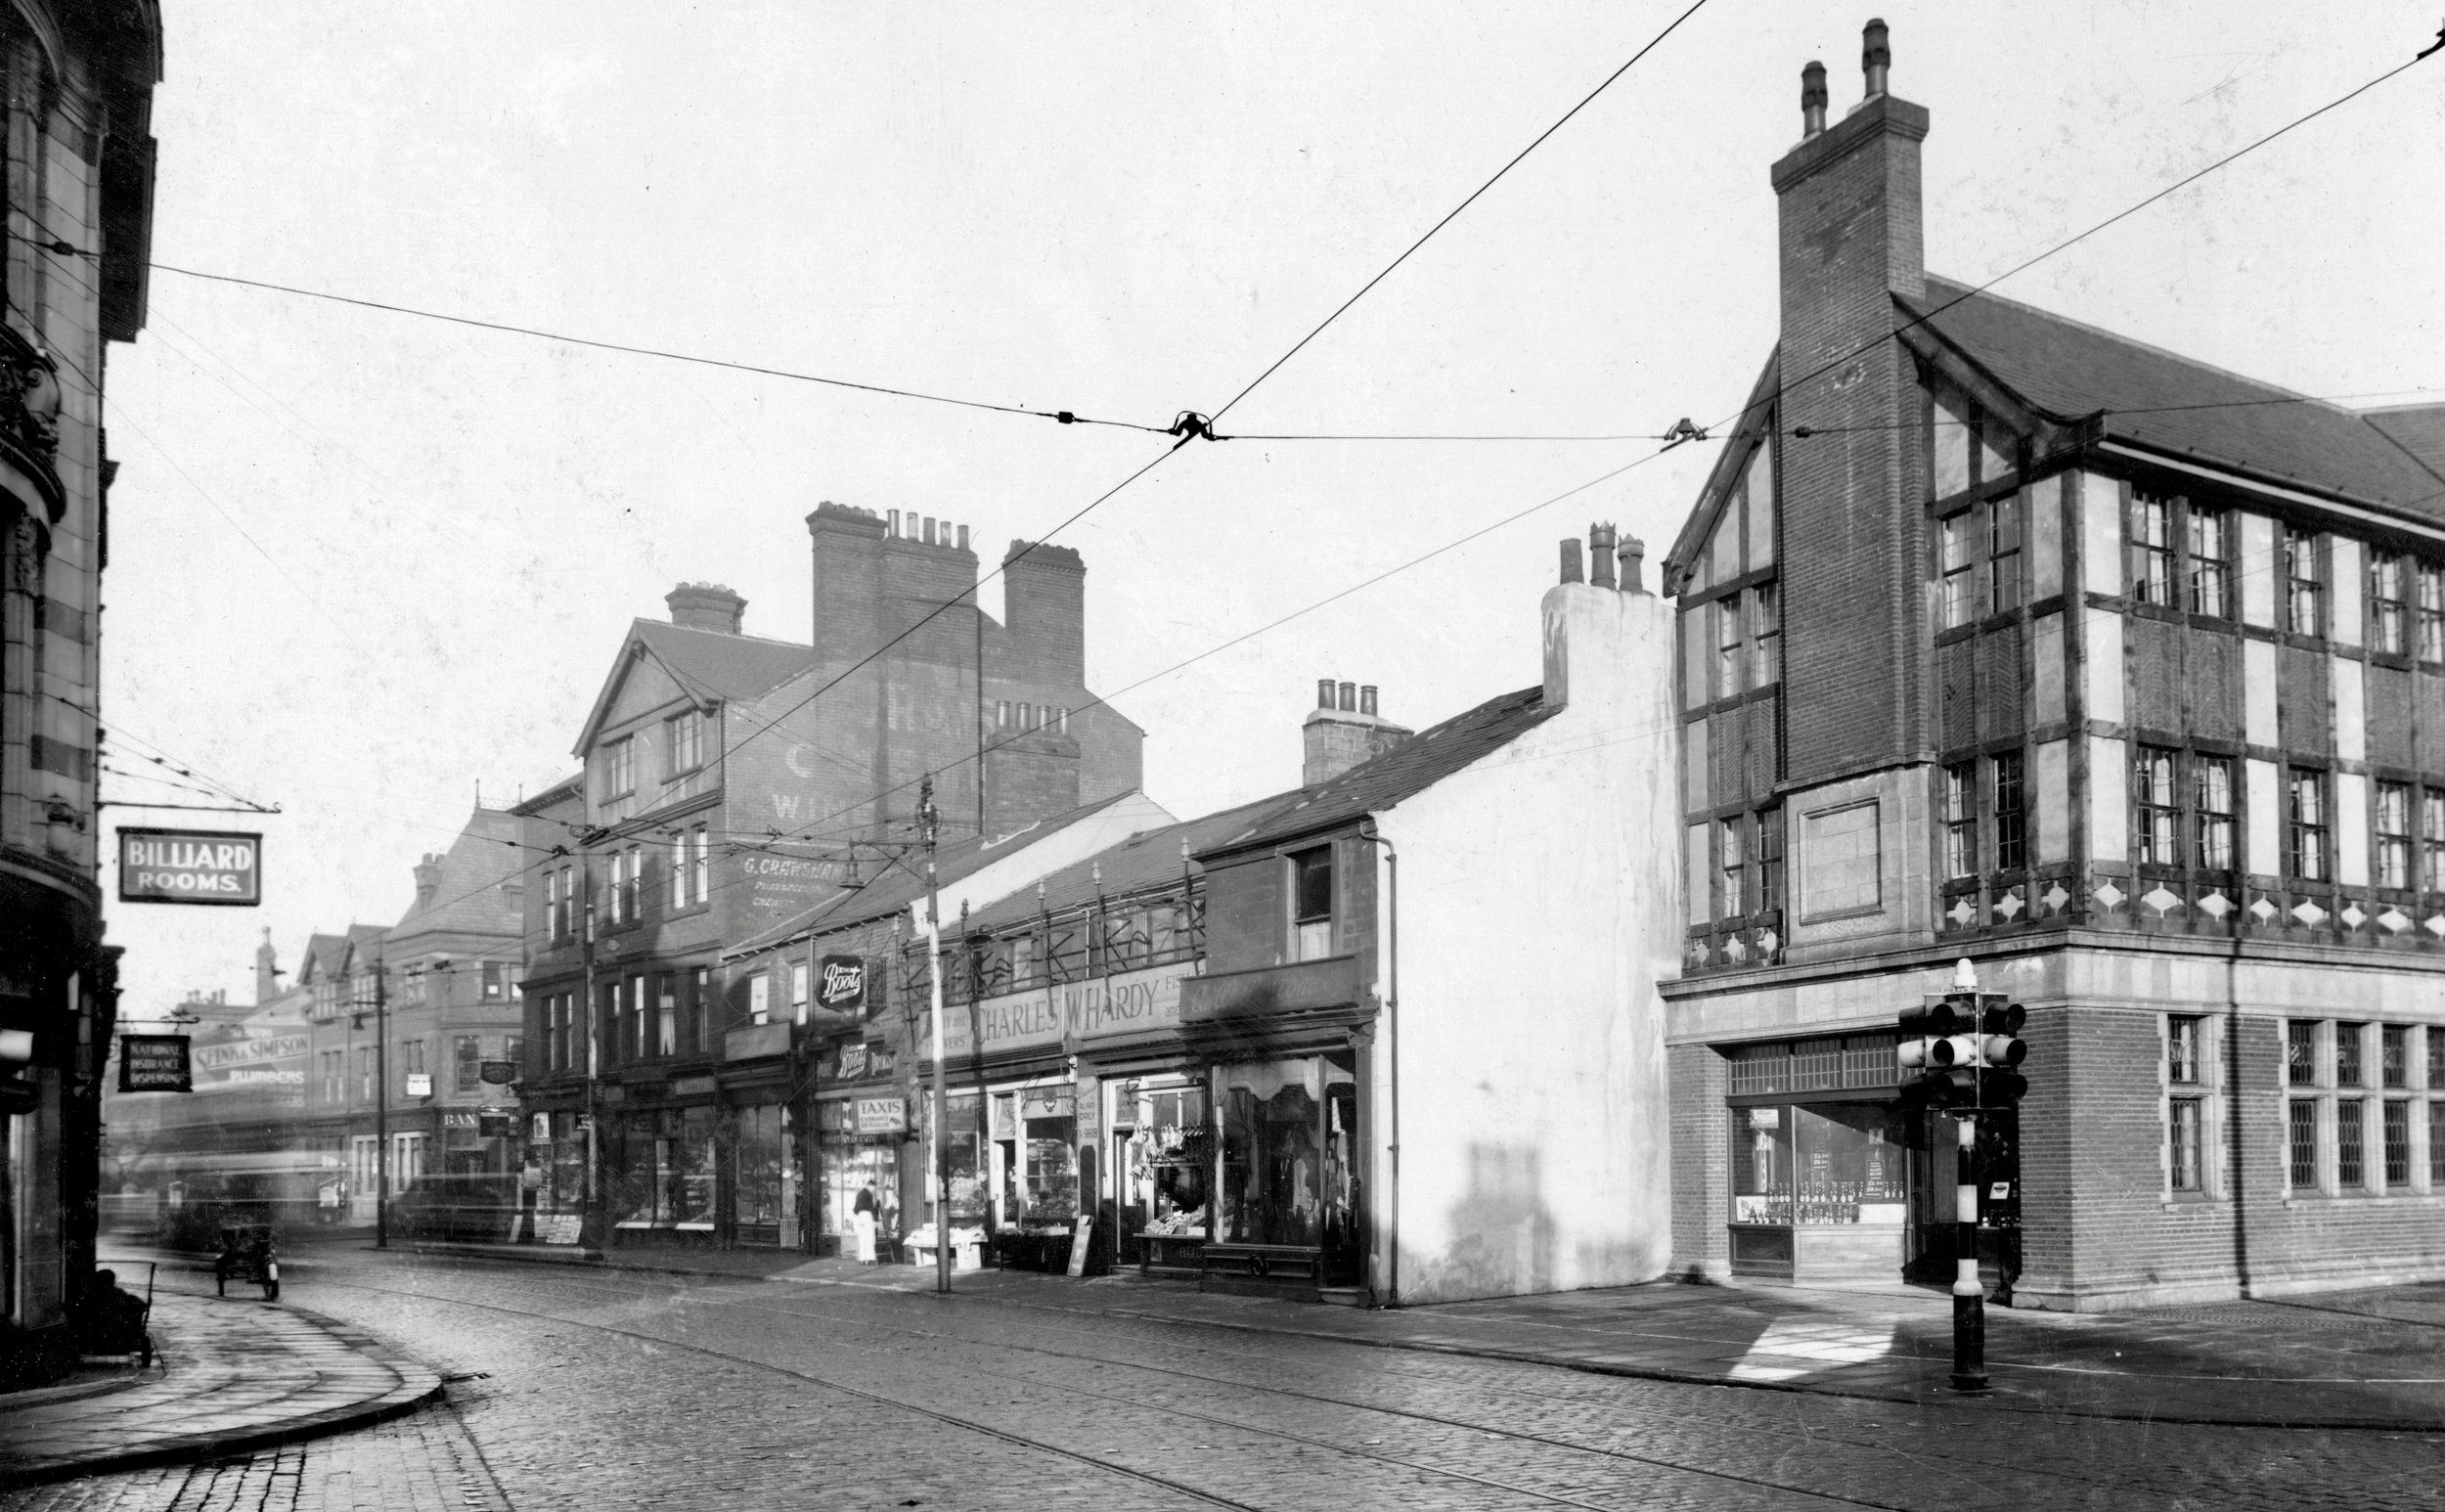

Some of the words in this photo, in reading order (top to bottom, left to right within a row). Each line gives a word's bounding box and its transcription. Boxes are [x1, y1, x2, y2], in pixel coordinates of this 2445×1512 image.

[128, 840, 252, 870] BILLIARD
[138, 871, 243, 892] ROOMS.
[822, 962, 863, 999] Boots
[977, 997, 1059, 1045] CHARLES
[1087, 979, 1160, 1030] HARDY
[250, 1036, 308, 1057] SIMPSON
[230, 1070, 304, 1085] PLUMBERS
[861, 1100, 901, 1115] TAXIS
